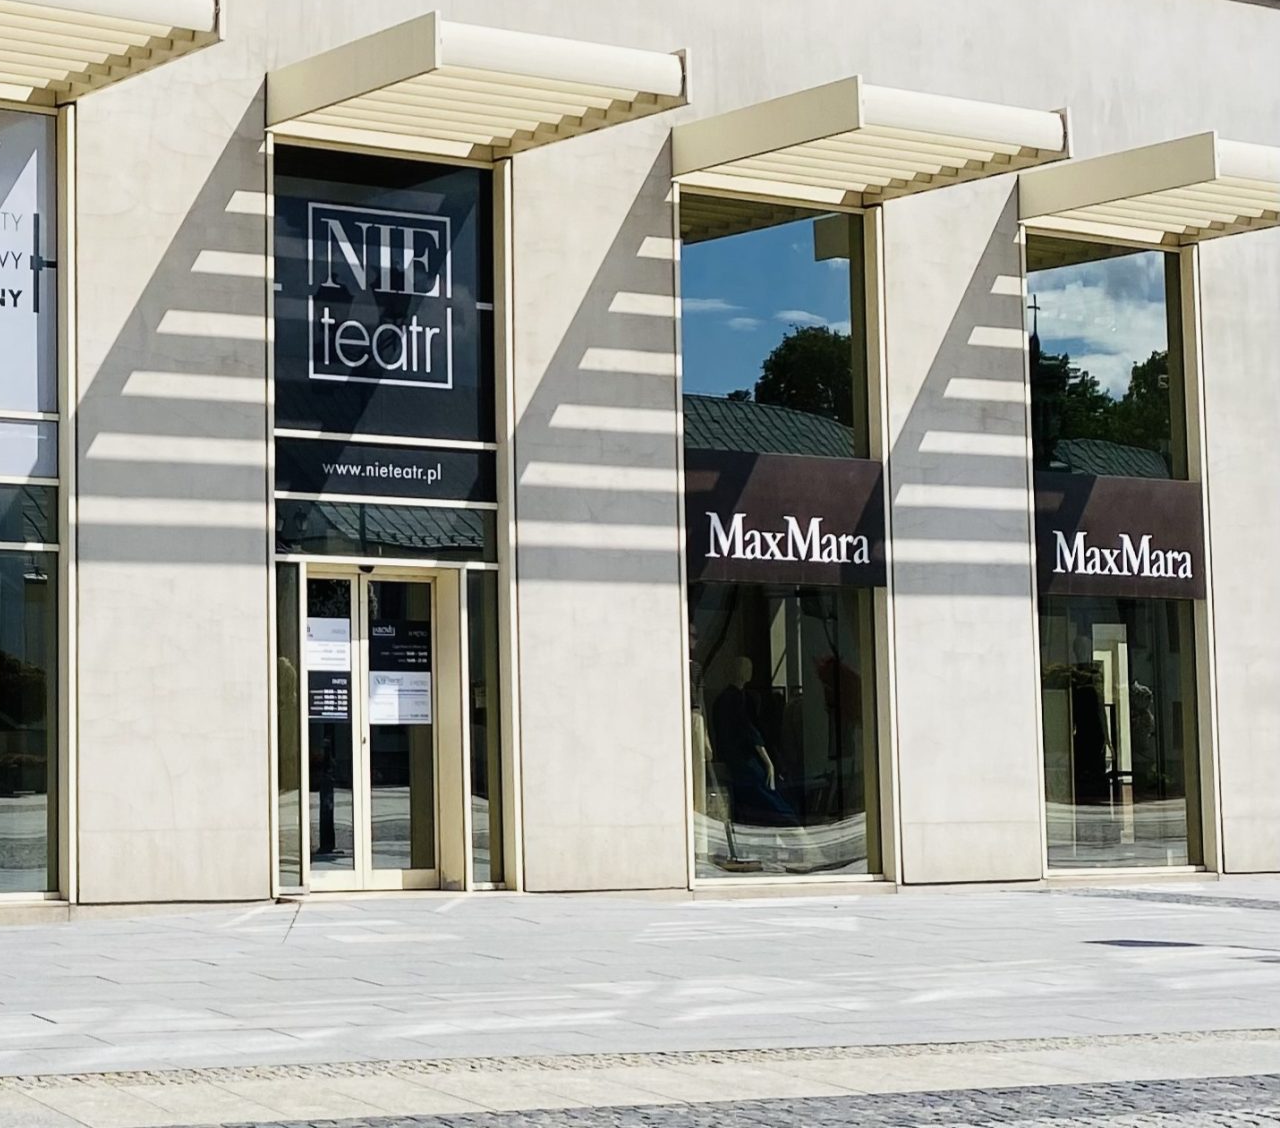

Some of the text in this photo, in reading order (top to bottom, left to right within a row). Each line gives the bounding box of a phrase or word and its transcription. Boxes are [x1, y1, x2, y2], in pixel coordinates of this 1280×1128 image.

[321, 217, 441, 298] NIE
[320, 306, 441, 373] teatr
[322, 461, 442, 485] www.nieteatr.pl
[704, 511, 871, 564] MaxMara
[1051, 530, 1194, 579] MaxMara
